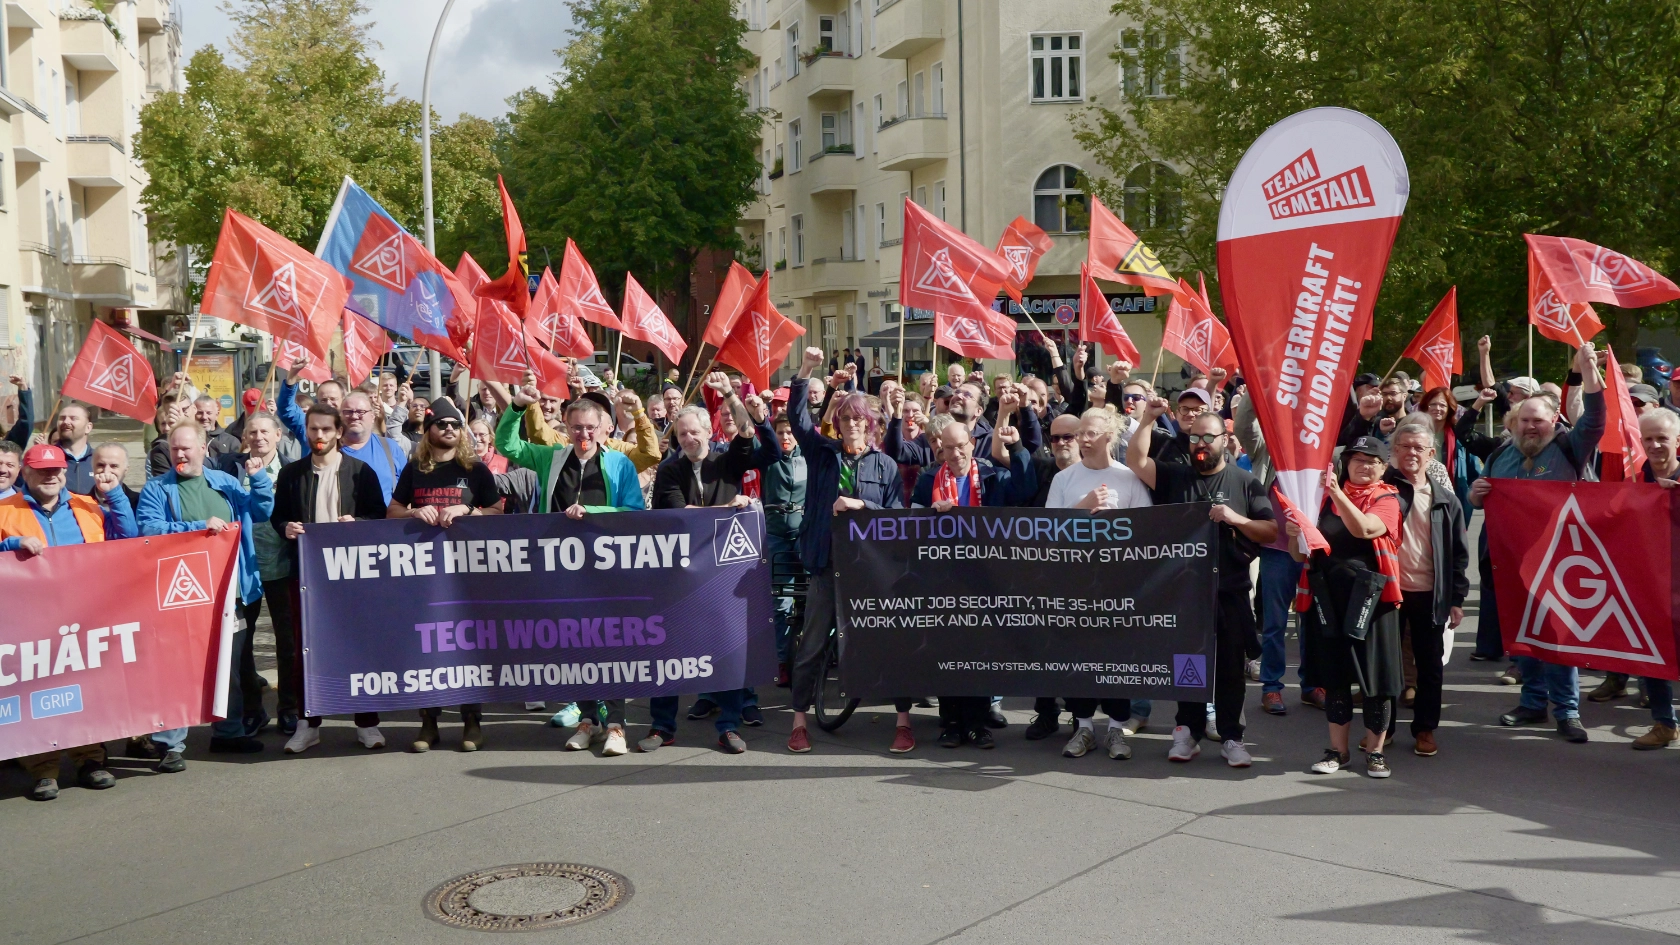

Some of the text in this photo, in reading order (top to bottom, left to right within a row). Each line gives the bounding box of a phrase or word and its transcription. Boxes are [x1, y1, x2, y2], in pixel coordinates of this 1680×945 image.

[1264, 156, 1316, 197] TEAM
[1271, 172, 1371, 217] IG METALL
[703, 304, 710, 315] 2
[1009, 297, 1155, 314] BÄCKER CAFE
[1276, 242, 1334, 410] SUPERKRAFT
[1300, 276, 1362, 450] SOLIDARITÄT!
[849, 515, 1133, 543] MBITION WORKERS
[443, 539, 531, 574] HERE
[537, 537, 586, 571] TO
[593, 533, 691, 570] STAY!
[918, 543, 1208, 563] FOR EQUAL INDUSTRY STANDARDS
[850, 596, 1135, 611] WE WANT JOB SECURITY, THE 35-HOUR
[414, 615, 667, 653] TECH WORKERS
[850, 613, 1177, 628] WORK WEEK AND A VISION FOR OUR FUTURE!
[0, 621, 141, 686] CHÄFT
[937, 662, 956, 670] WE
[957, 662, 990, 670] PATCH
[991, 662, 1043, 671] SYSTEMS.
[1045, 662, 1070, 671] NOW
[1105, 663, 1139, 673] FIXING
[1140, 664, 1171, 673] OURS.
[350, 655, 713, 696] FOR SECURE AUTOMOTIVE JOBS
[1095, 675, 1171, 686] UNIONIZE NOW!
[40, 691, 75, 711] GRIP
